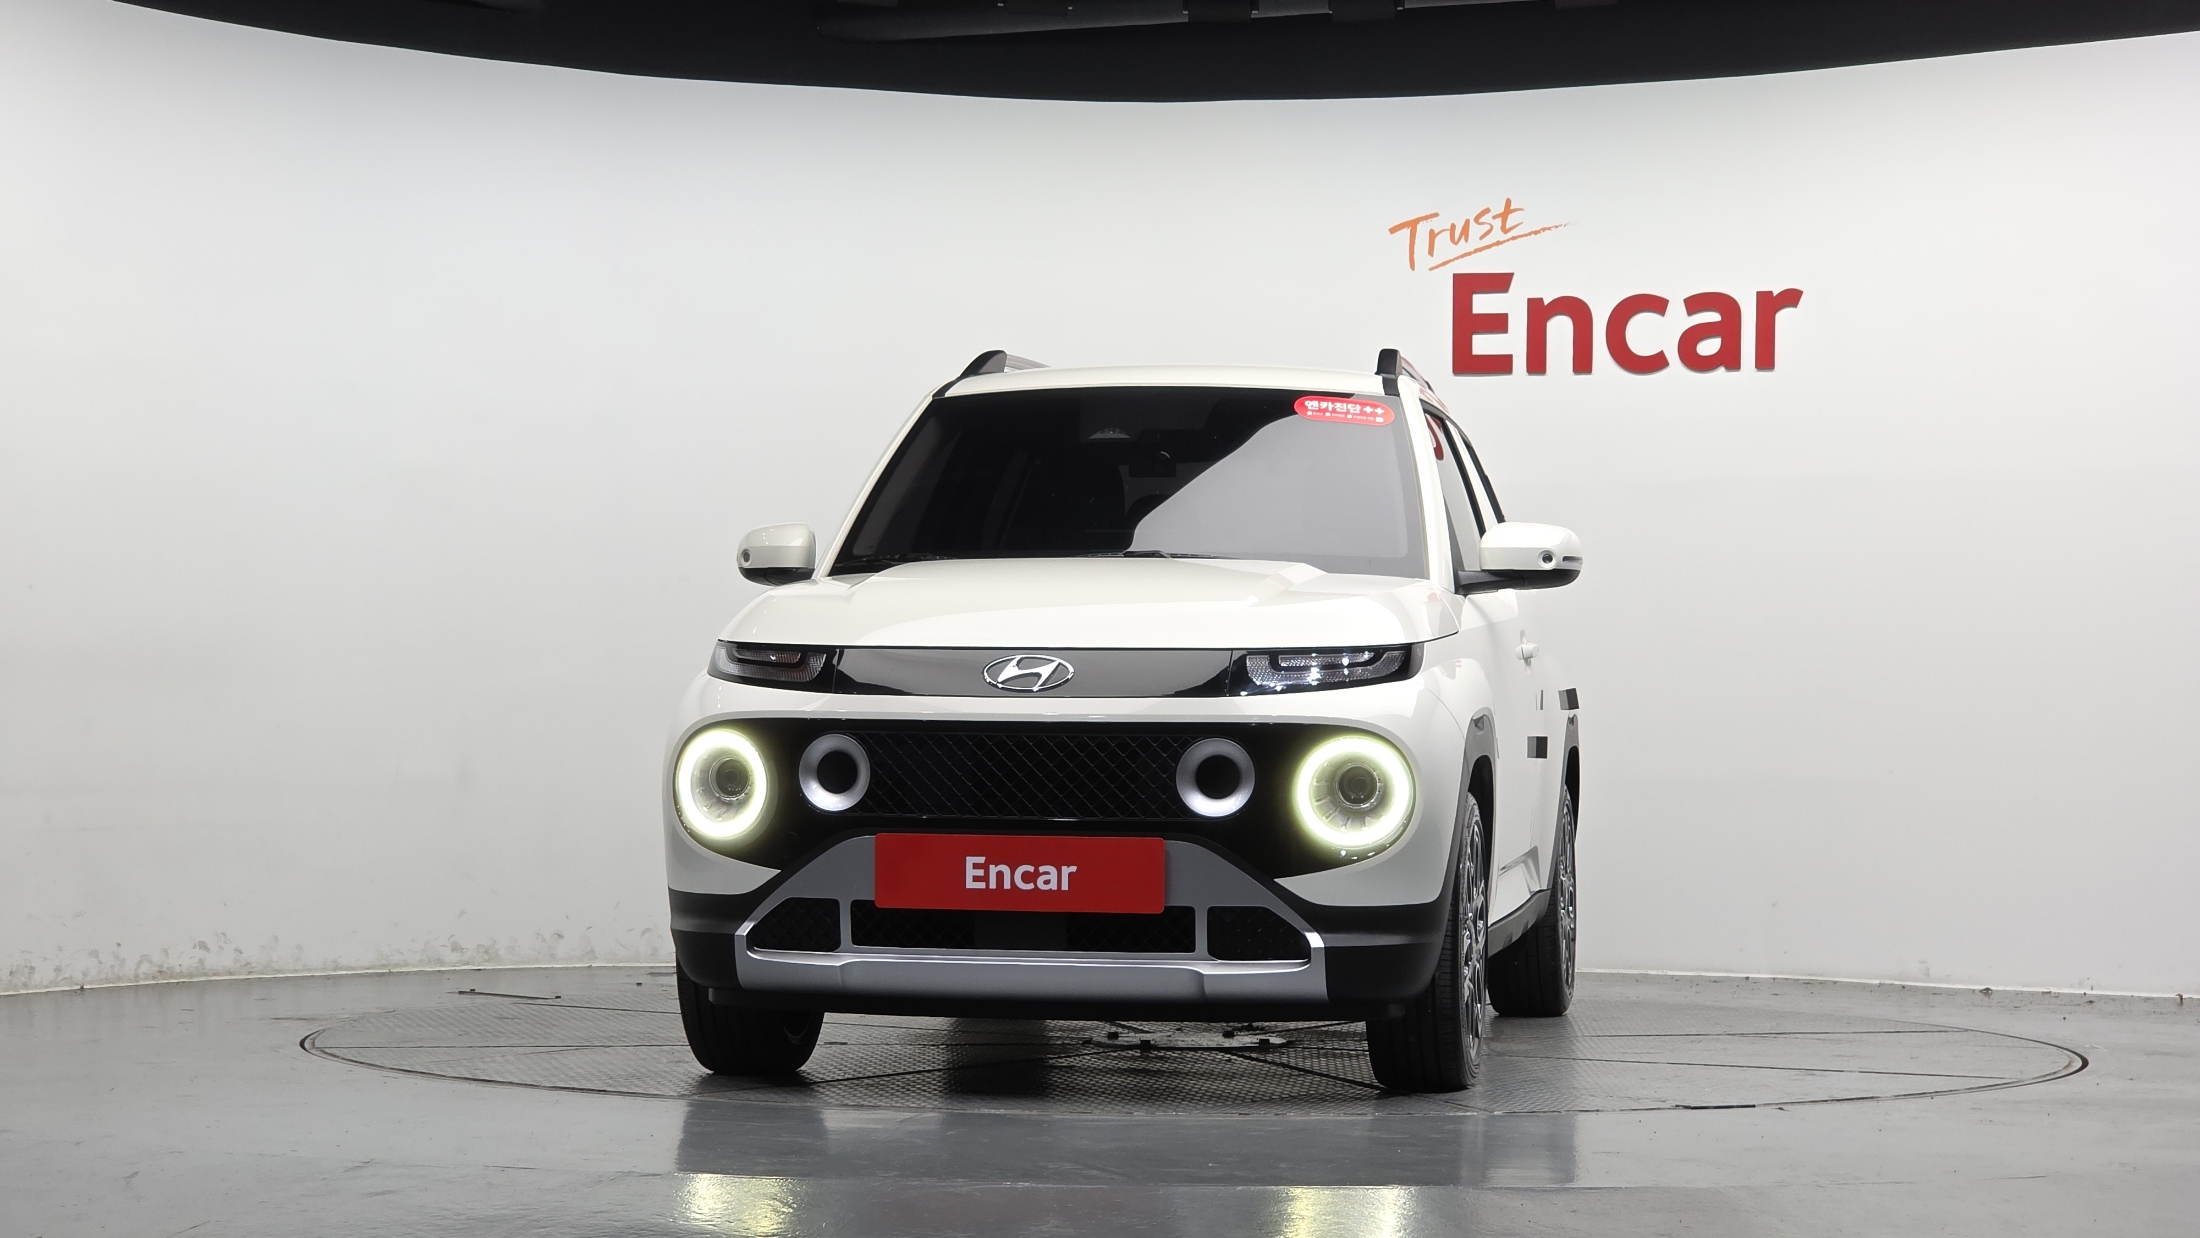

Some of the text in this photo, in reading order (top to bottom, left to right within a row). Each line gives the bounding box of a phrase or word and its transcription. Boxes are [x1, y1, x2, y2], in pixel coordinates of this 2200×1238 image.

[1388, 197, 1525, 271] Trust
[1452, 272, 1804, 375] Encar
[965, 856, 1078, 891] Encar
